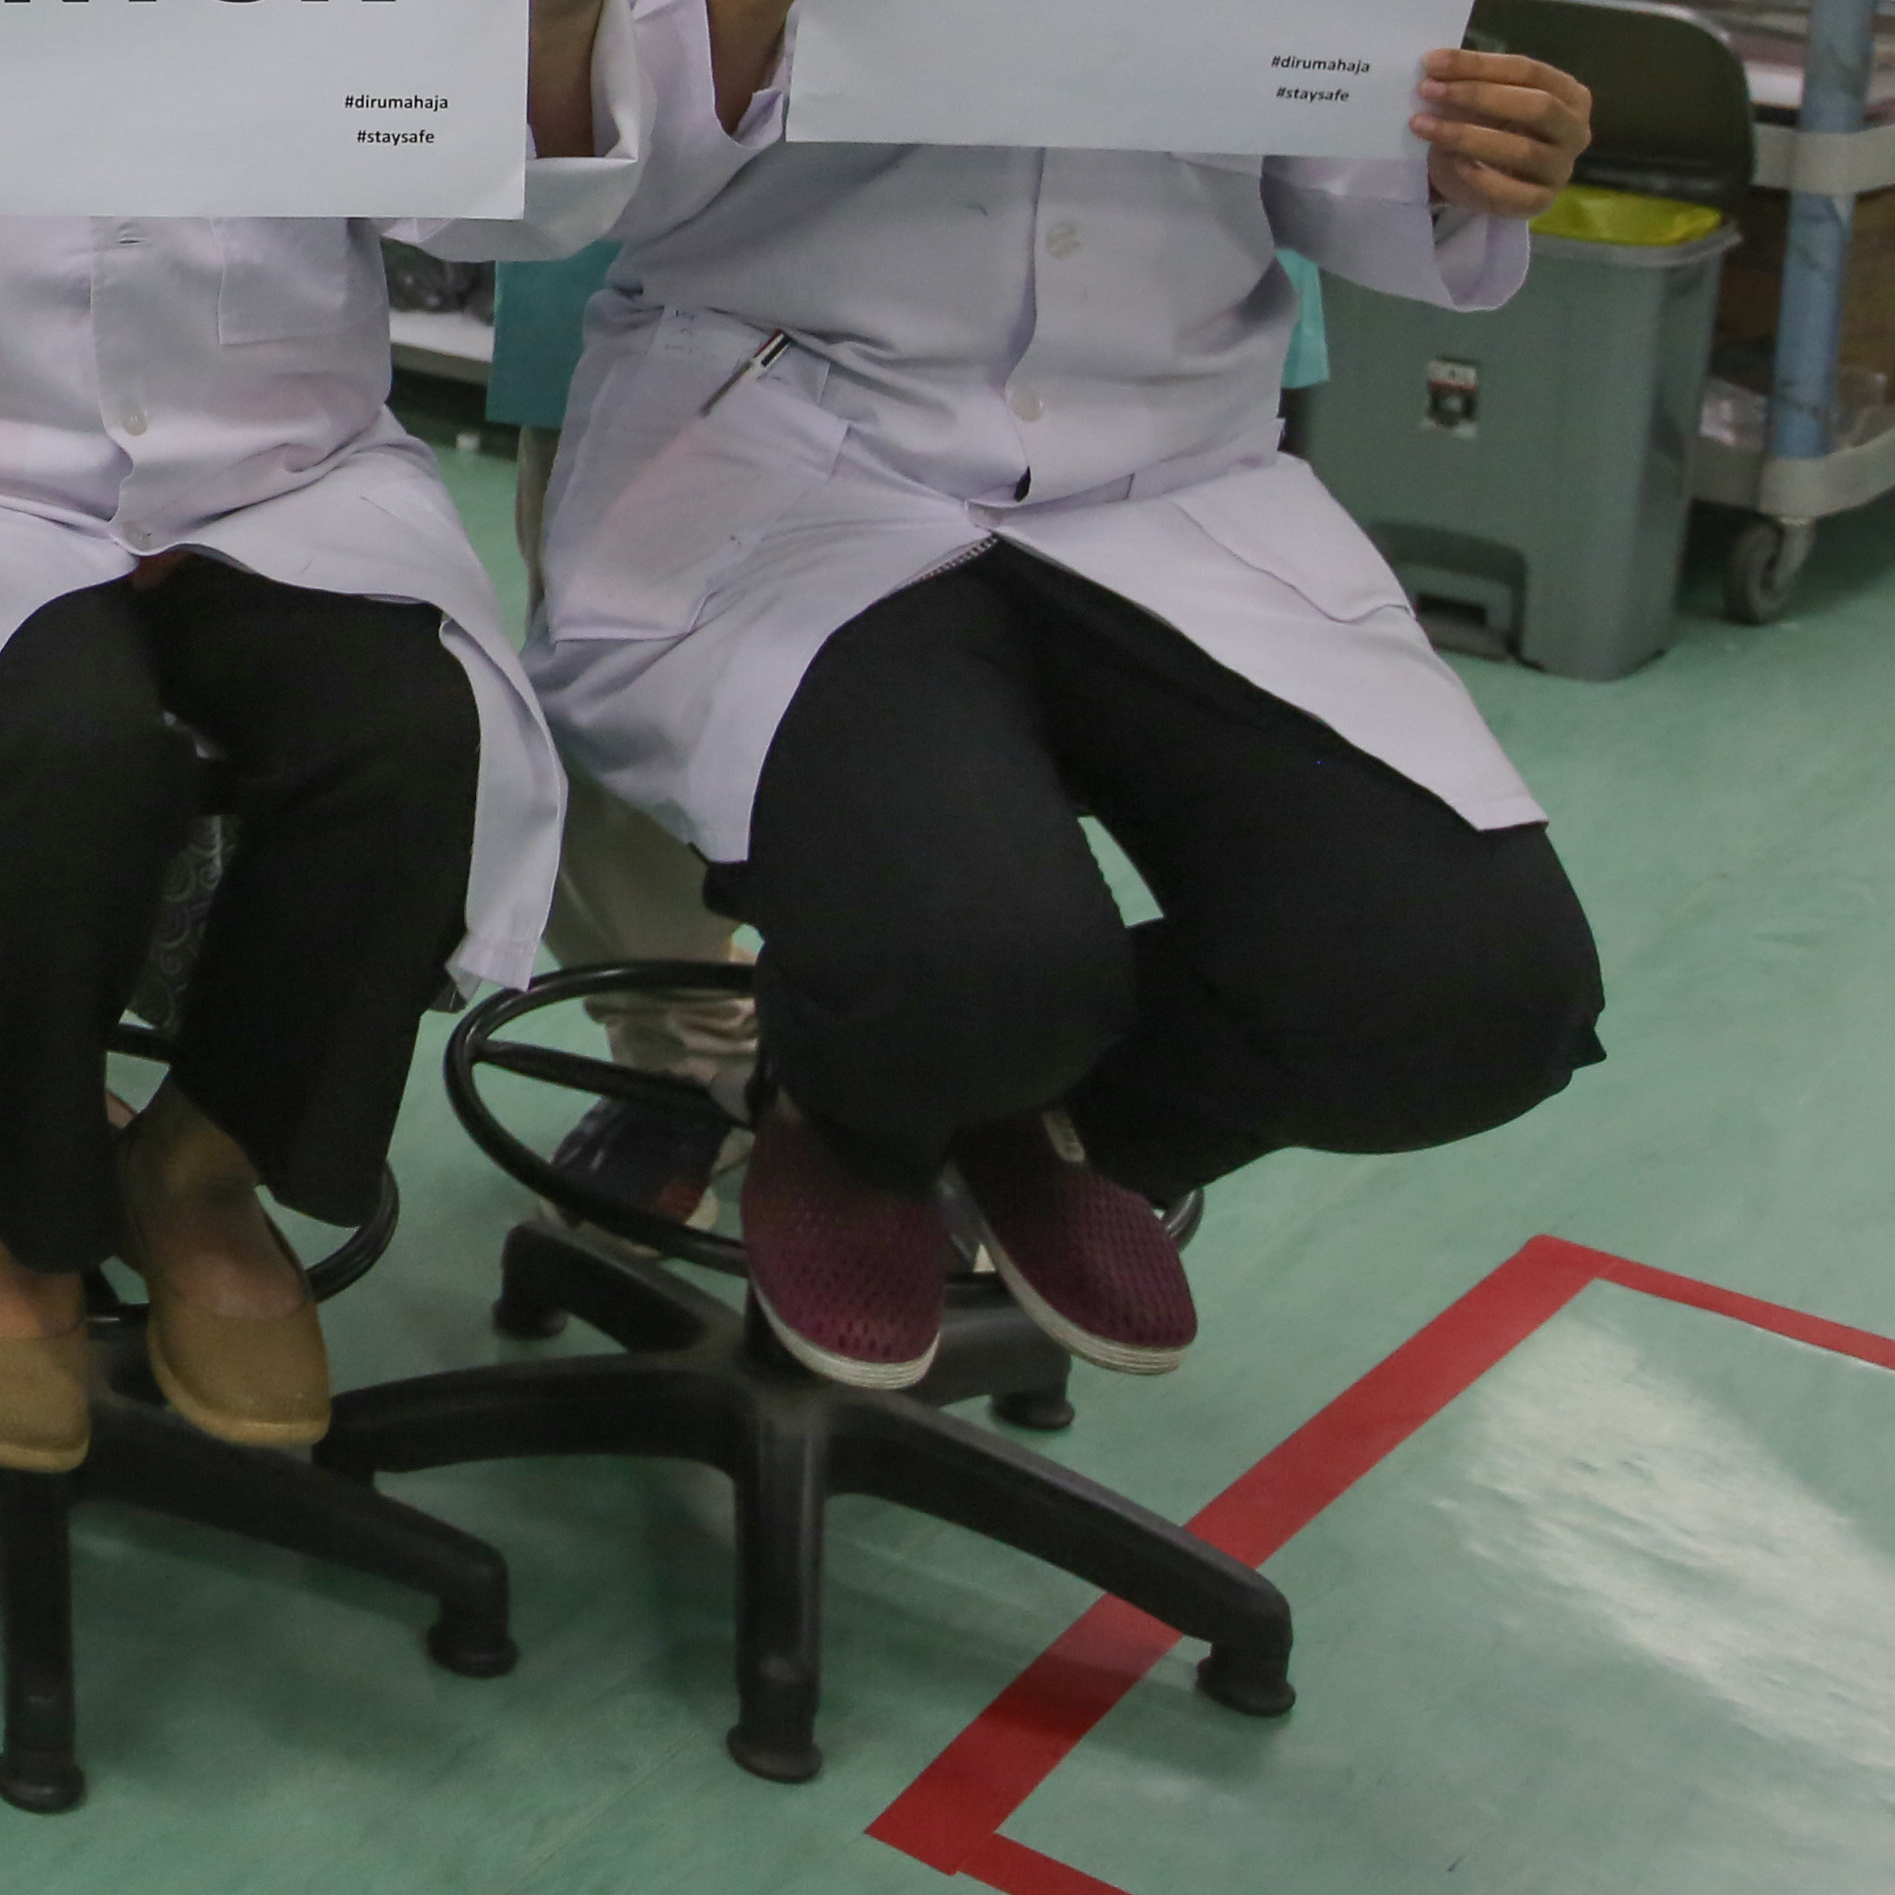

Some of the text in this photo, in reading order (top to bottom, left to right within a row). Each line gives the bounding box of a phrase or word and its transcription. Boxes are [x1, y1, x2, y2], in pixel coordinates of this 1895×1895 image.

[1271, 56, 1370, 75] #dirumahaja
[1276, 87, 1349, 103] #staysafe
[344, 95, 448, 112] #dirumahaja
[357, 130, 435, 146] #staysafe
